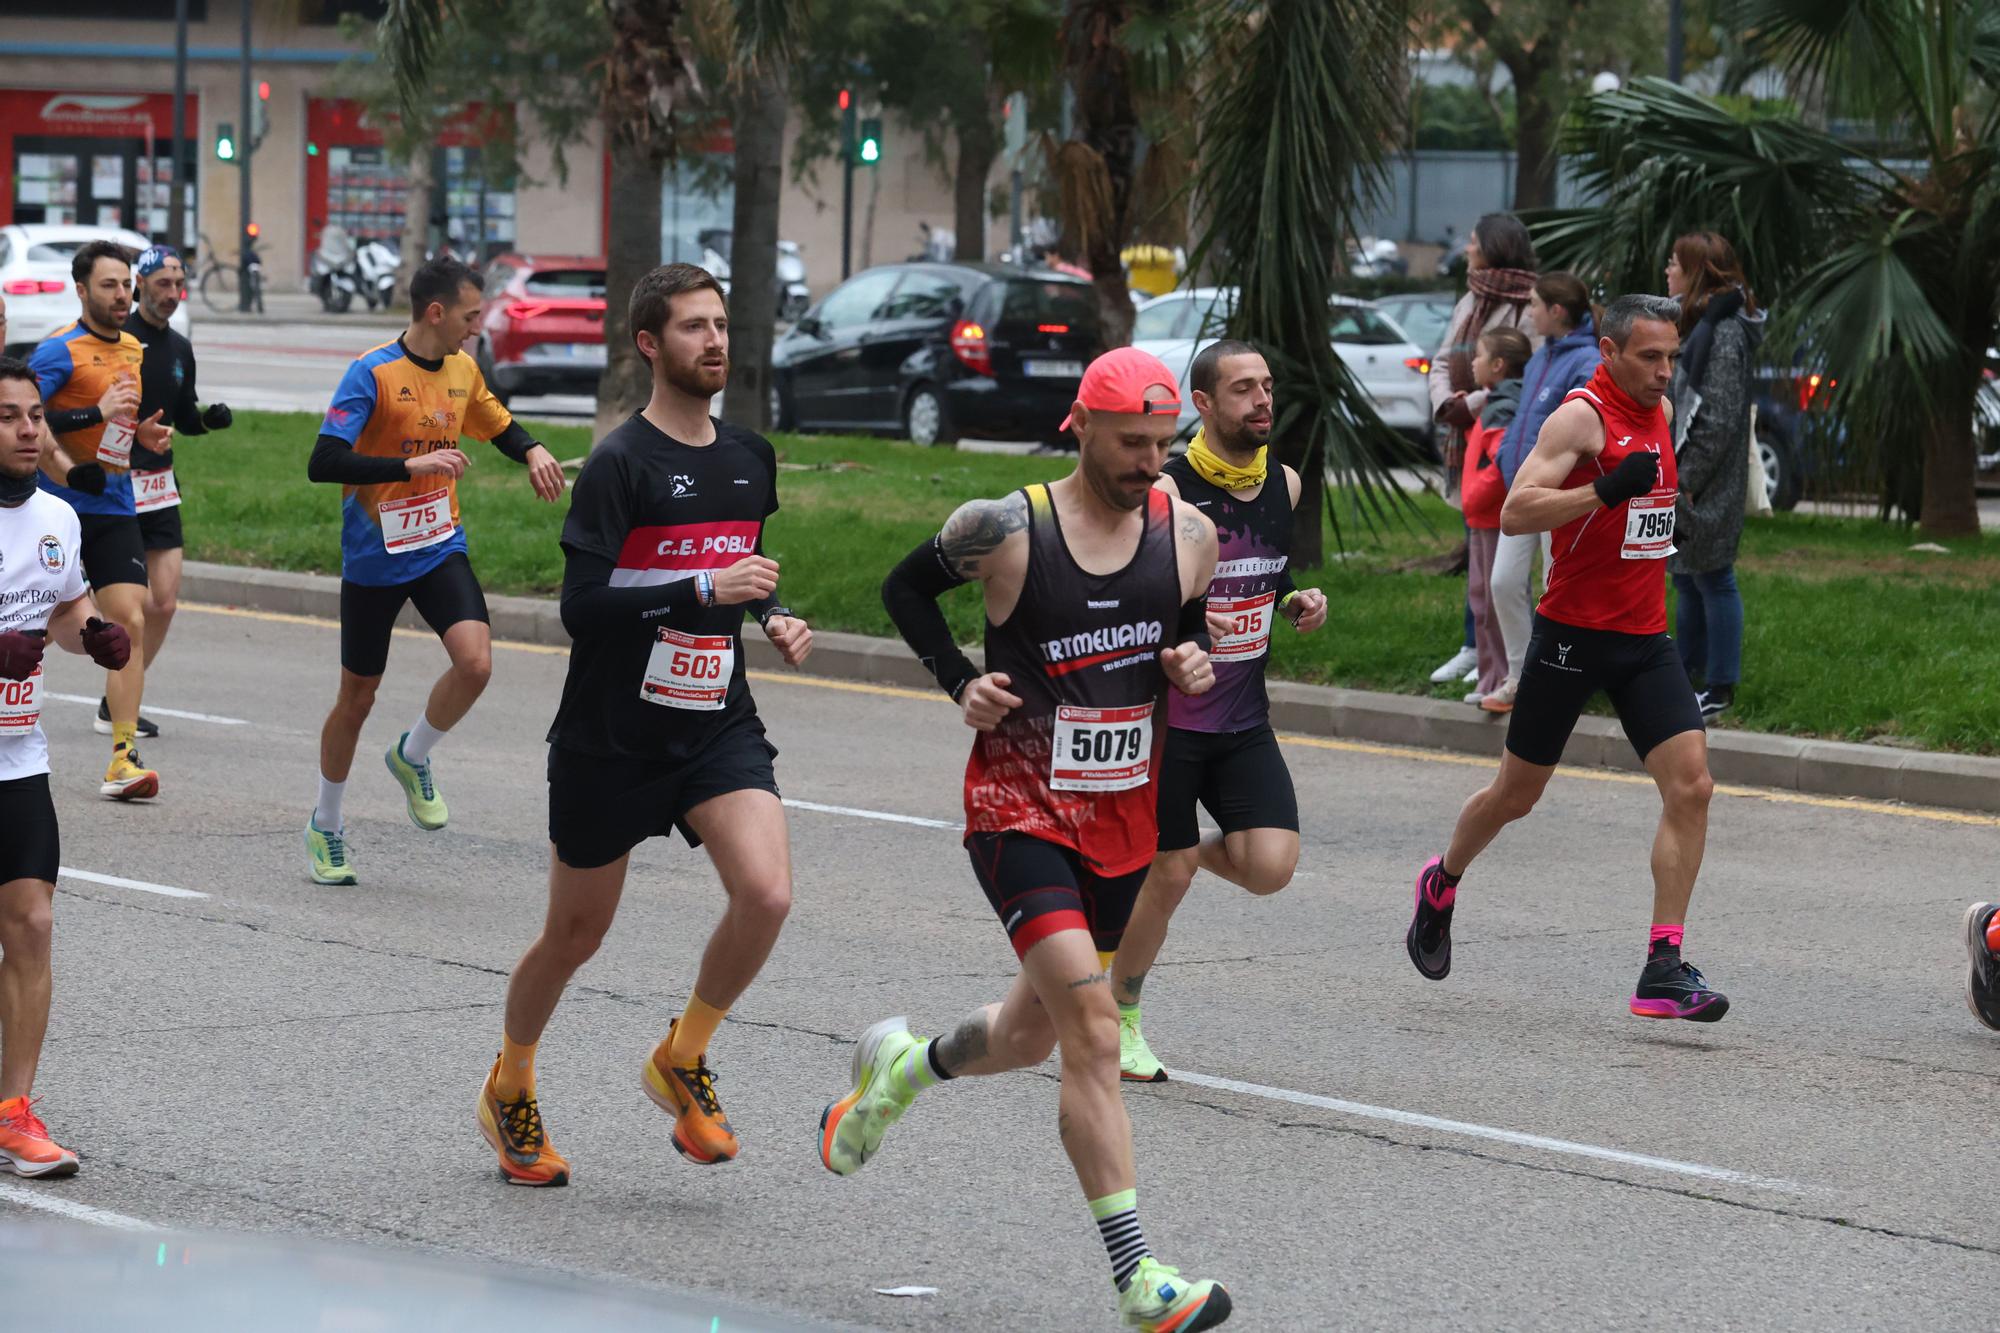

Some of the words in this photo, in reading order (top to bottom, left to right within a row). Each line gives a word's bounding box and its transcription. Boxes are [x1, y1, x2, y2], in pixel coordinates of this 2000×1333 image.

[141, 475, 166, 493] 746
[399, 506, 437, 529] 775
[1637, 511, 1673, 538] 7956
[657, 539, 696, 556] C.E.
[1209, 581, 1273, 594] ALZIR
[1231, 611, 1262, 636] 05
[670, 651, 721, 679] 503
[1071, 727, 1142, 762] 5079
